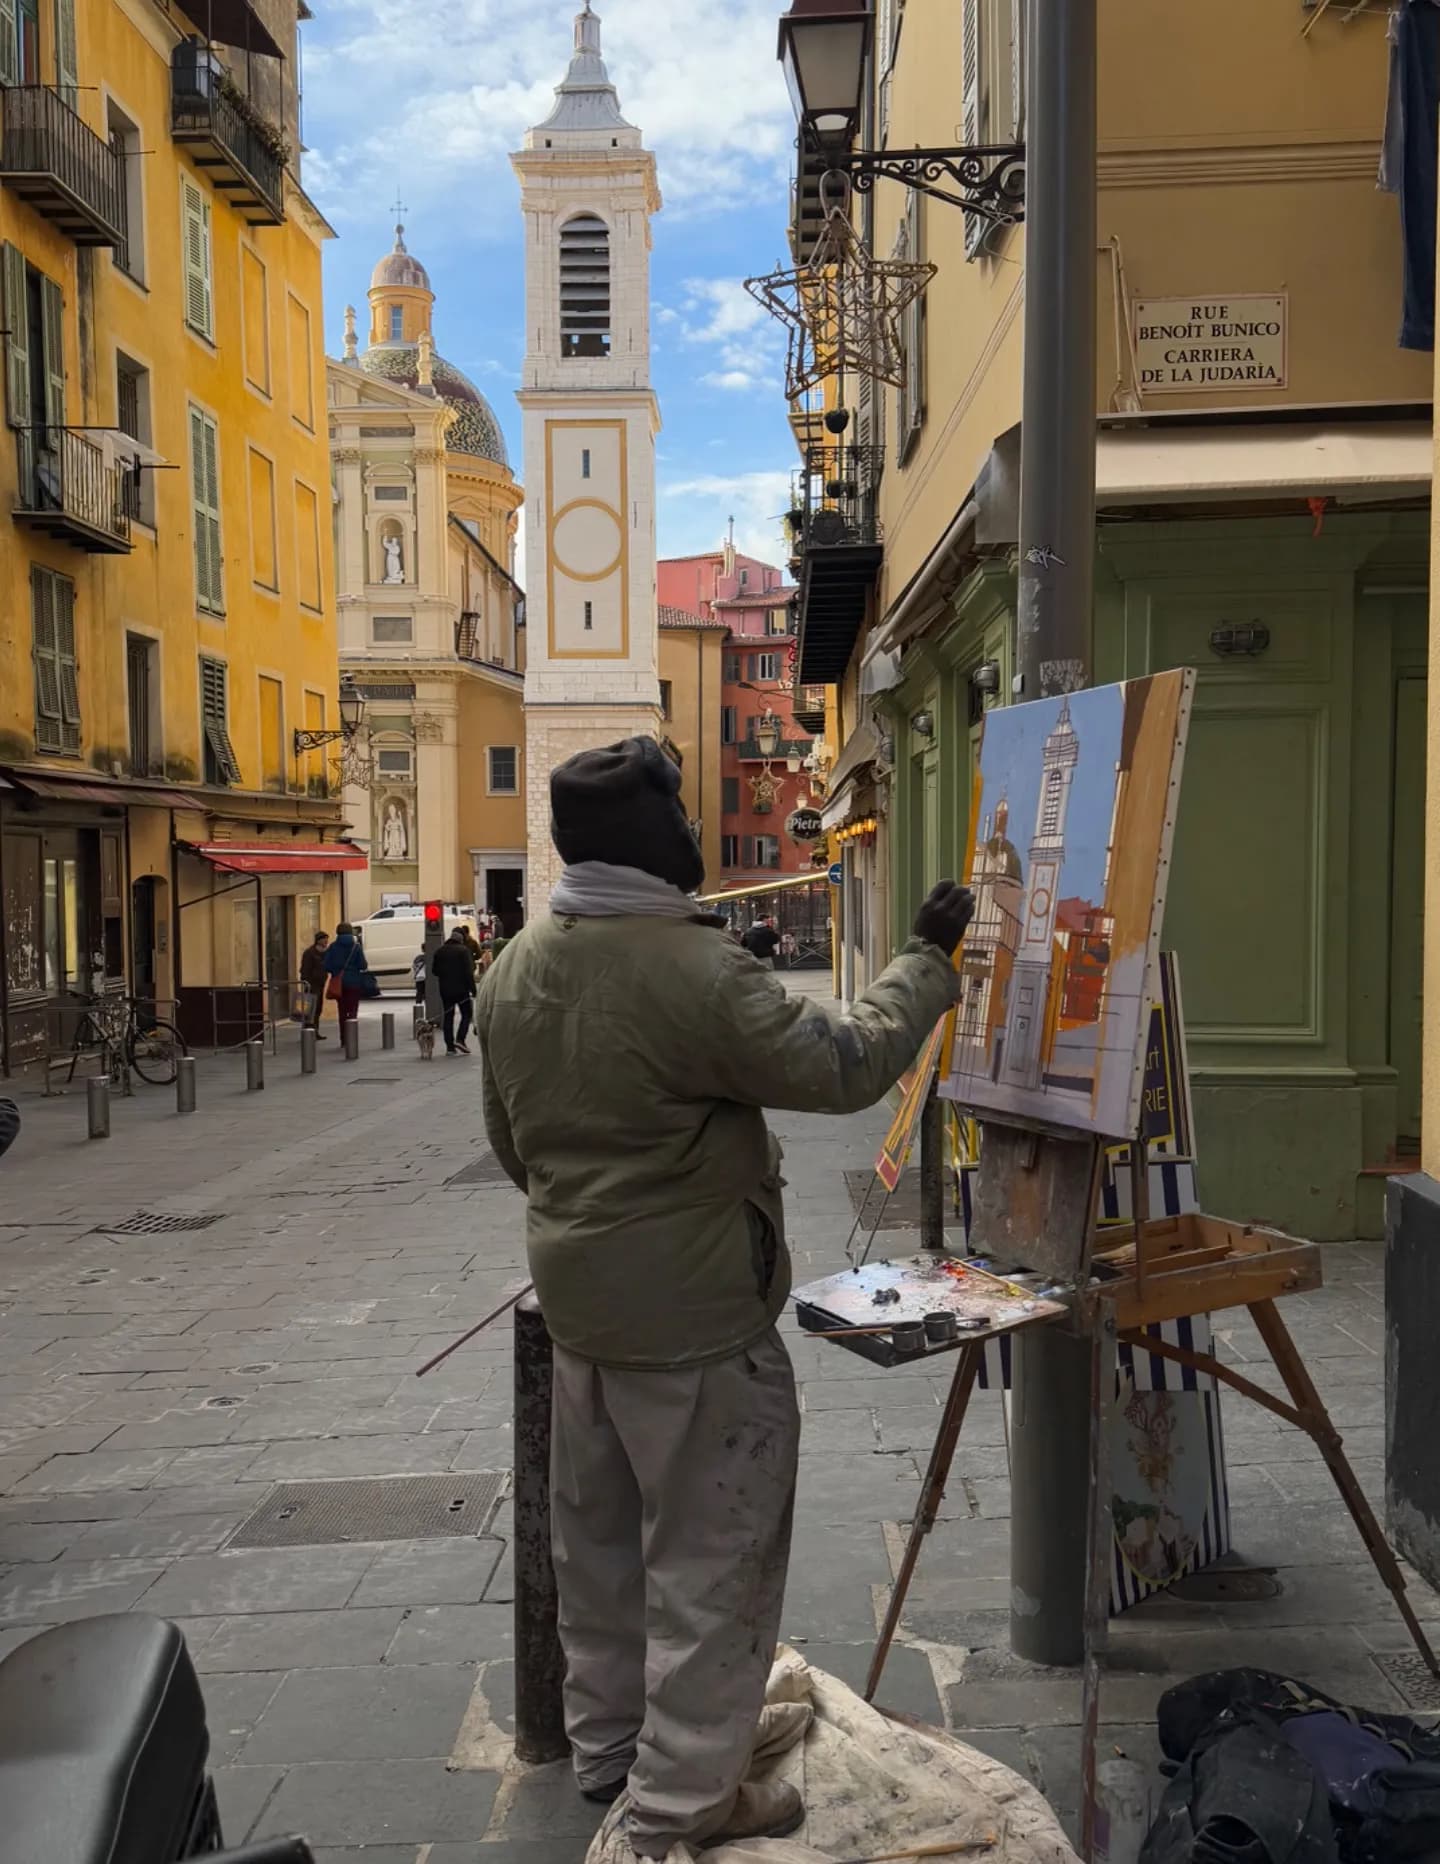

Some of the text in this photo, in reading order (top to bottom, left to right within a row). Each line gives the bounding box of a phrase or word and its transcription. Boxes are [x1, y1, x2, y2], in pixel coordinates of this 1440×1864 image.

[1191, 306, 1228, 319] RUE
[1211, 322, 1281, 337] BUNICO
[1164, 347, 1255, 364] CARRIERA
[1141, 369, 1164, 383] DE
[1171, 368, 1193, 382] LA
[1143, 1086, 1168, 1113] RIE
